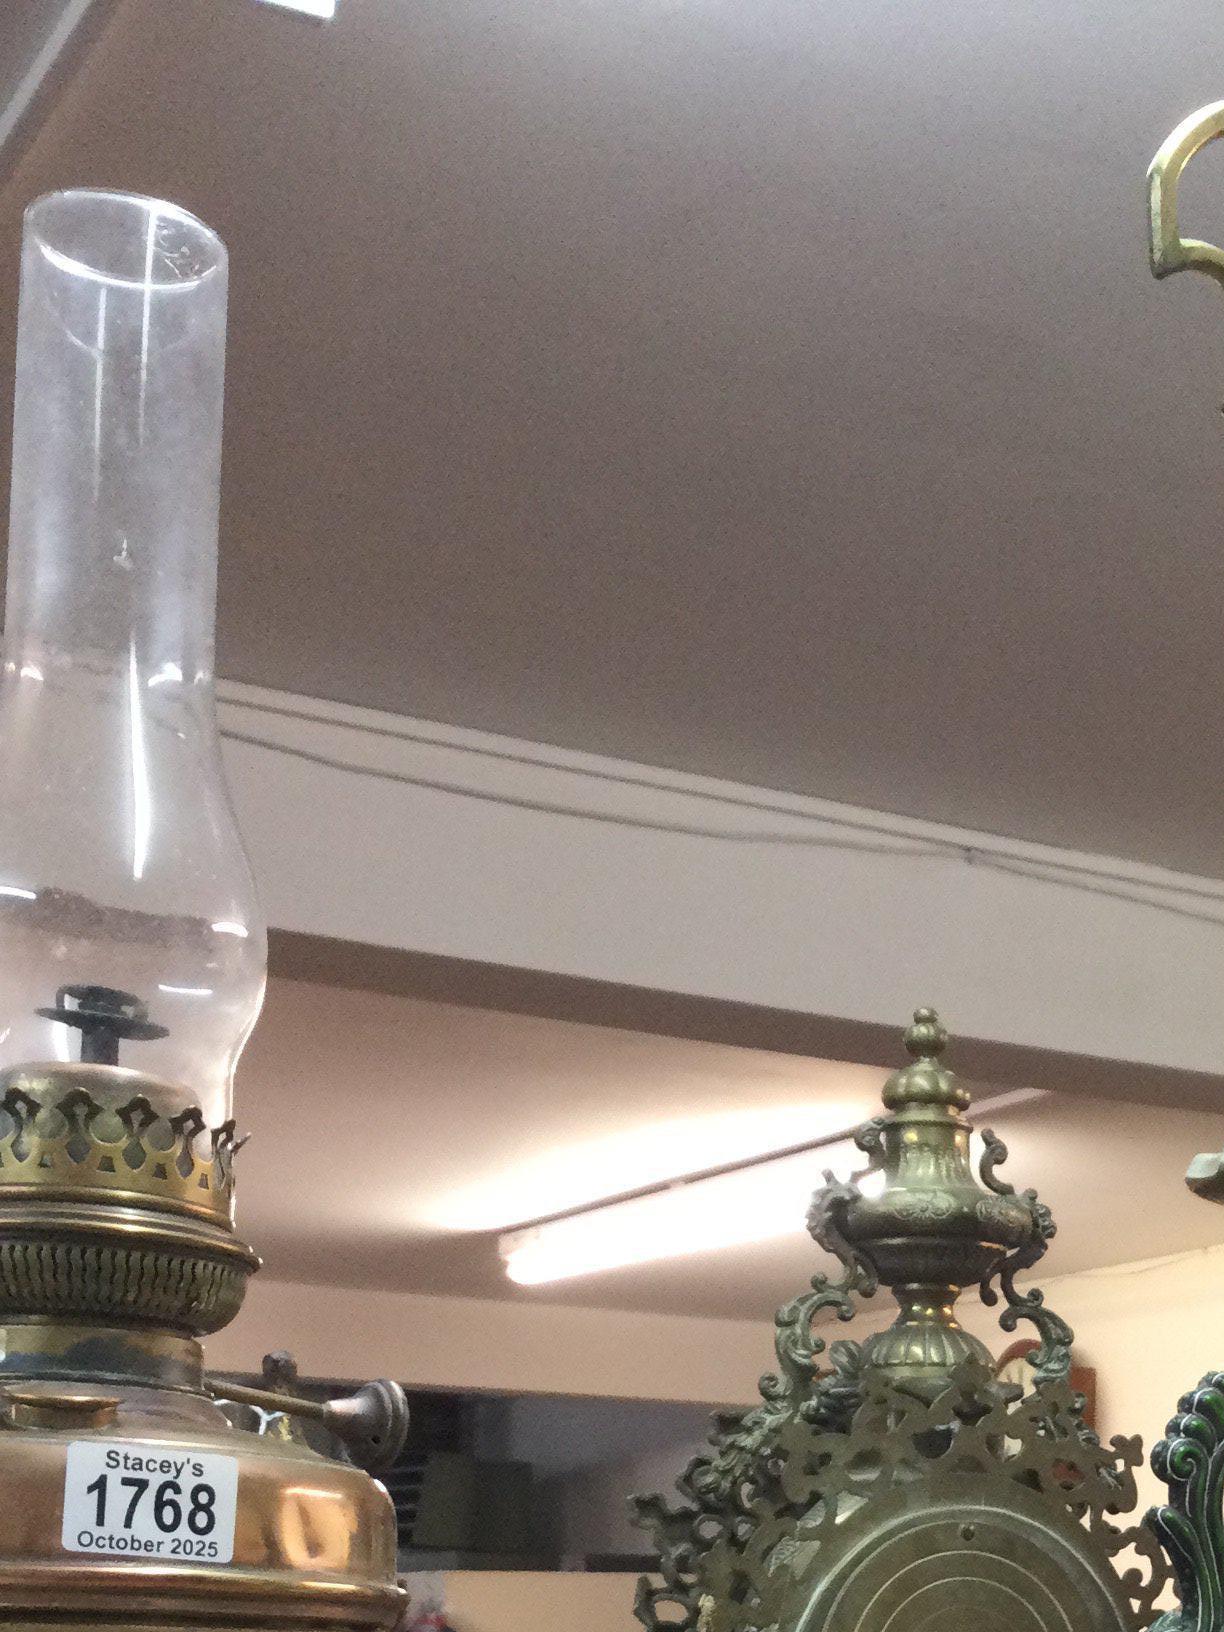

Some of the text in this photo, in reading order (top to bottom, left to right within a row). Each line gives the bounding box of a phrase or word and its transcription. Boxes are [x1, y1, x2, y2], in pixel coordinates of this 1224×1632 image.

[105, 1449, 204, 1479] Stacey's
[86, 1473, 216, 1536] 1768
[77, 1530, 218, 1558] October 2025
